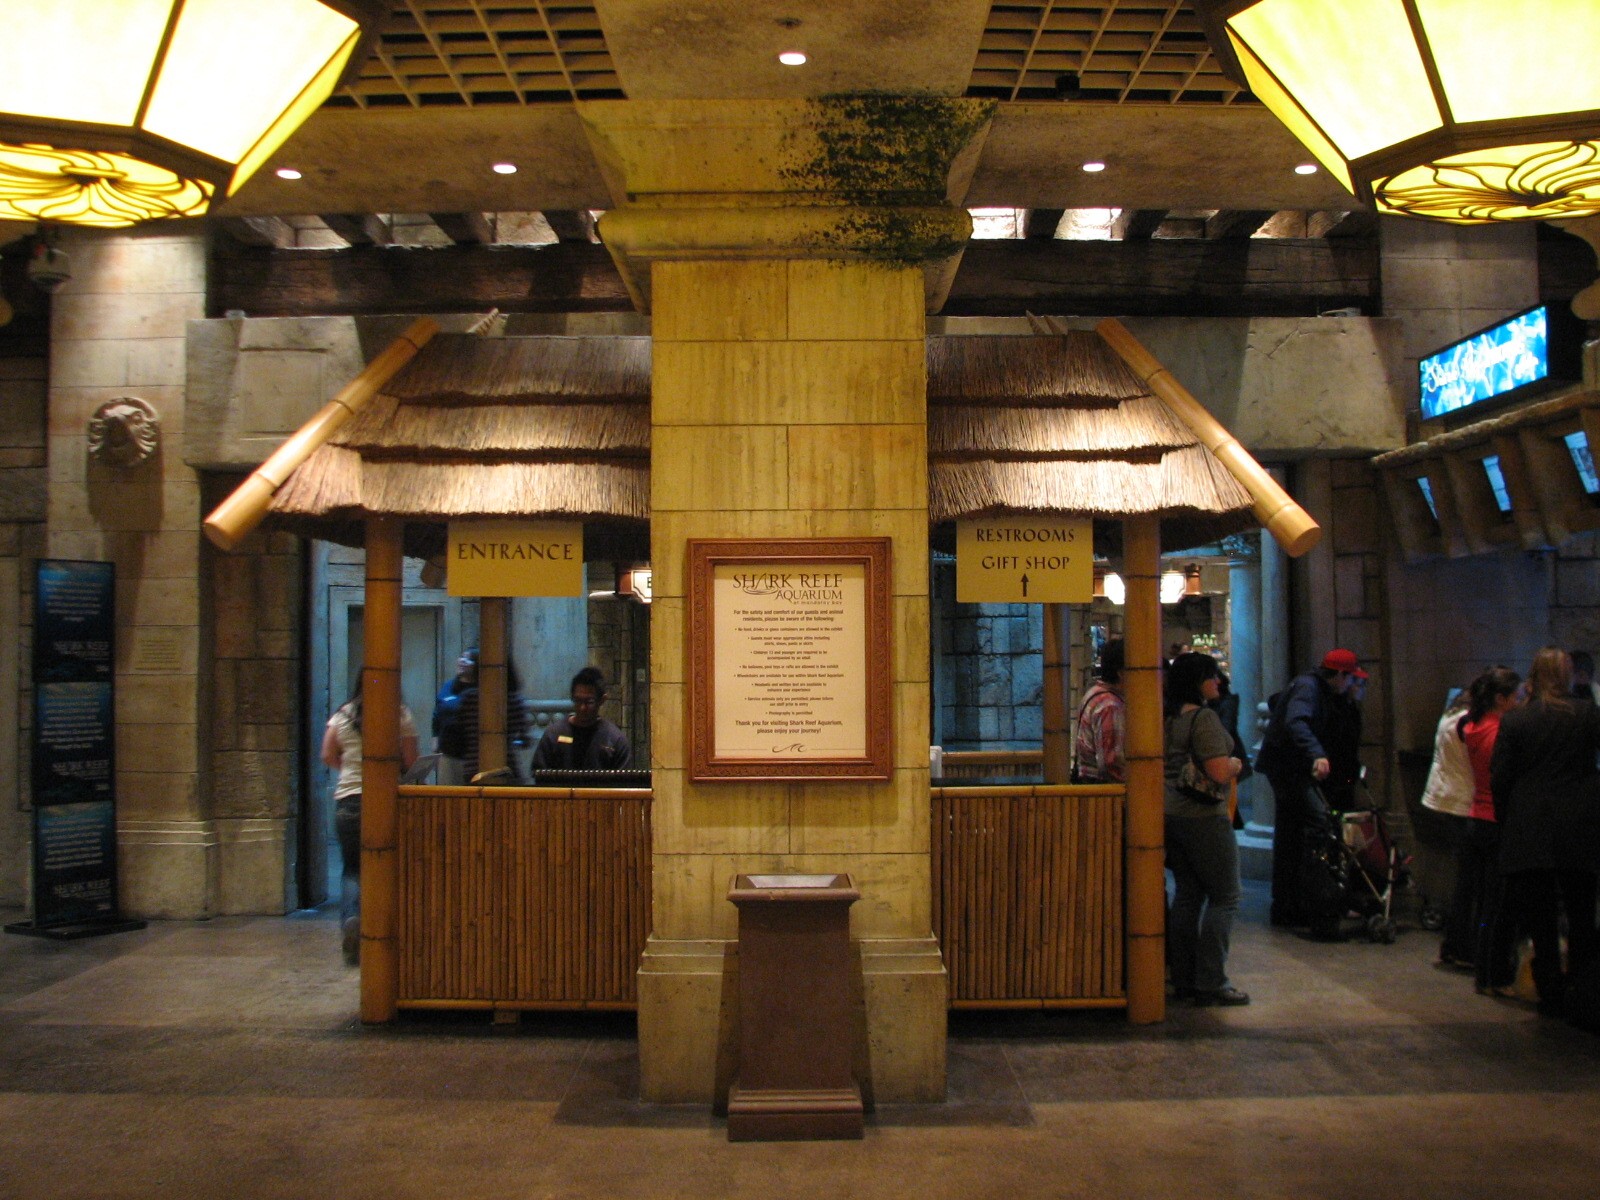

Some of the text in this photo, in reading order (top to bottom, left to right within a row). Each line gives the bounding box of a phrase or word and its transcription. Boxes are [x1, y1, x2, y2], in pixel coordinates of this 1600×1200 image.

[976, 528, 1074, 542] RESTROOMS
[458, 543, 573, 560] ENTRANCE
[981, 556, 1070, 570] GIFT SHOP
[732, 572, 843, 590] SHARK REEF
[775, 590, 842, 603] AQUARIUM
